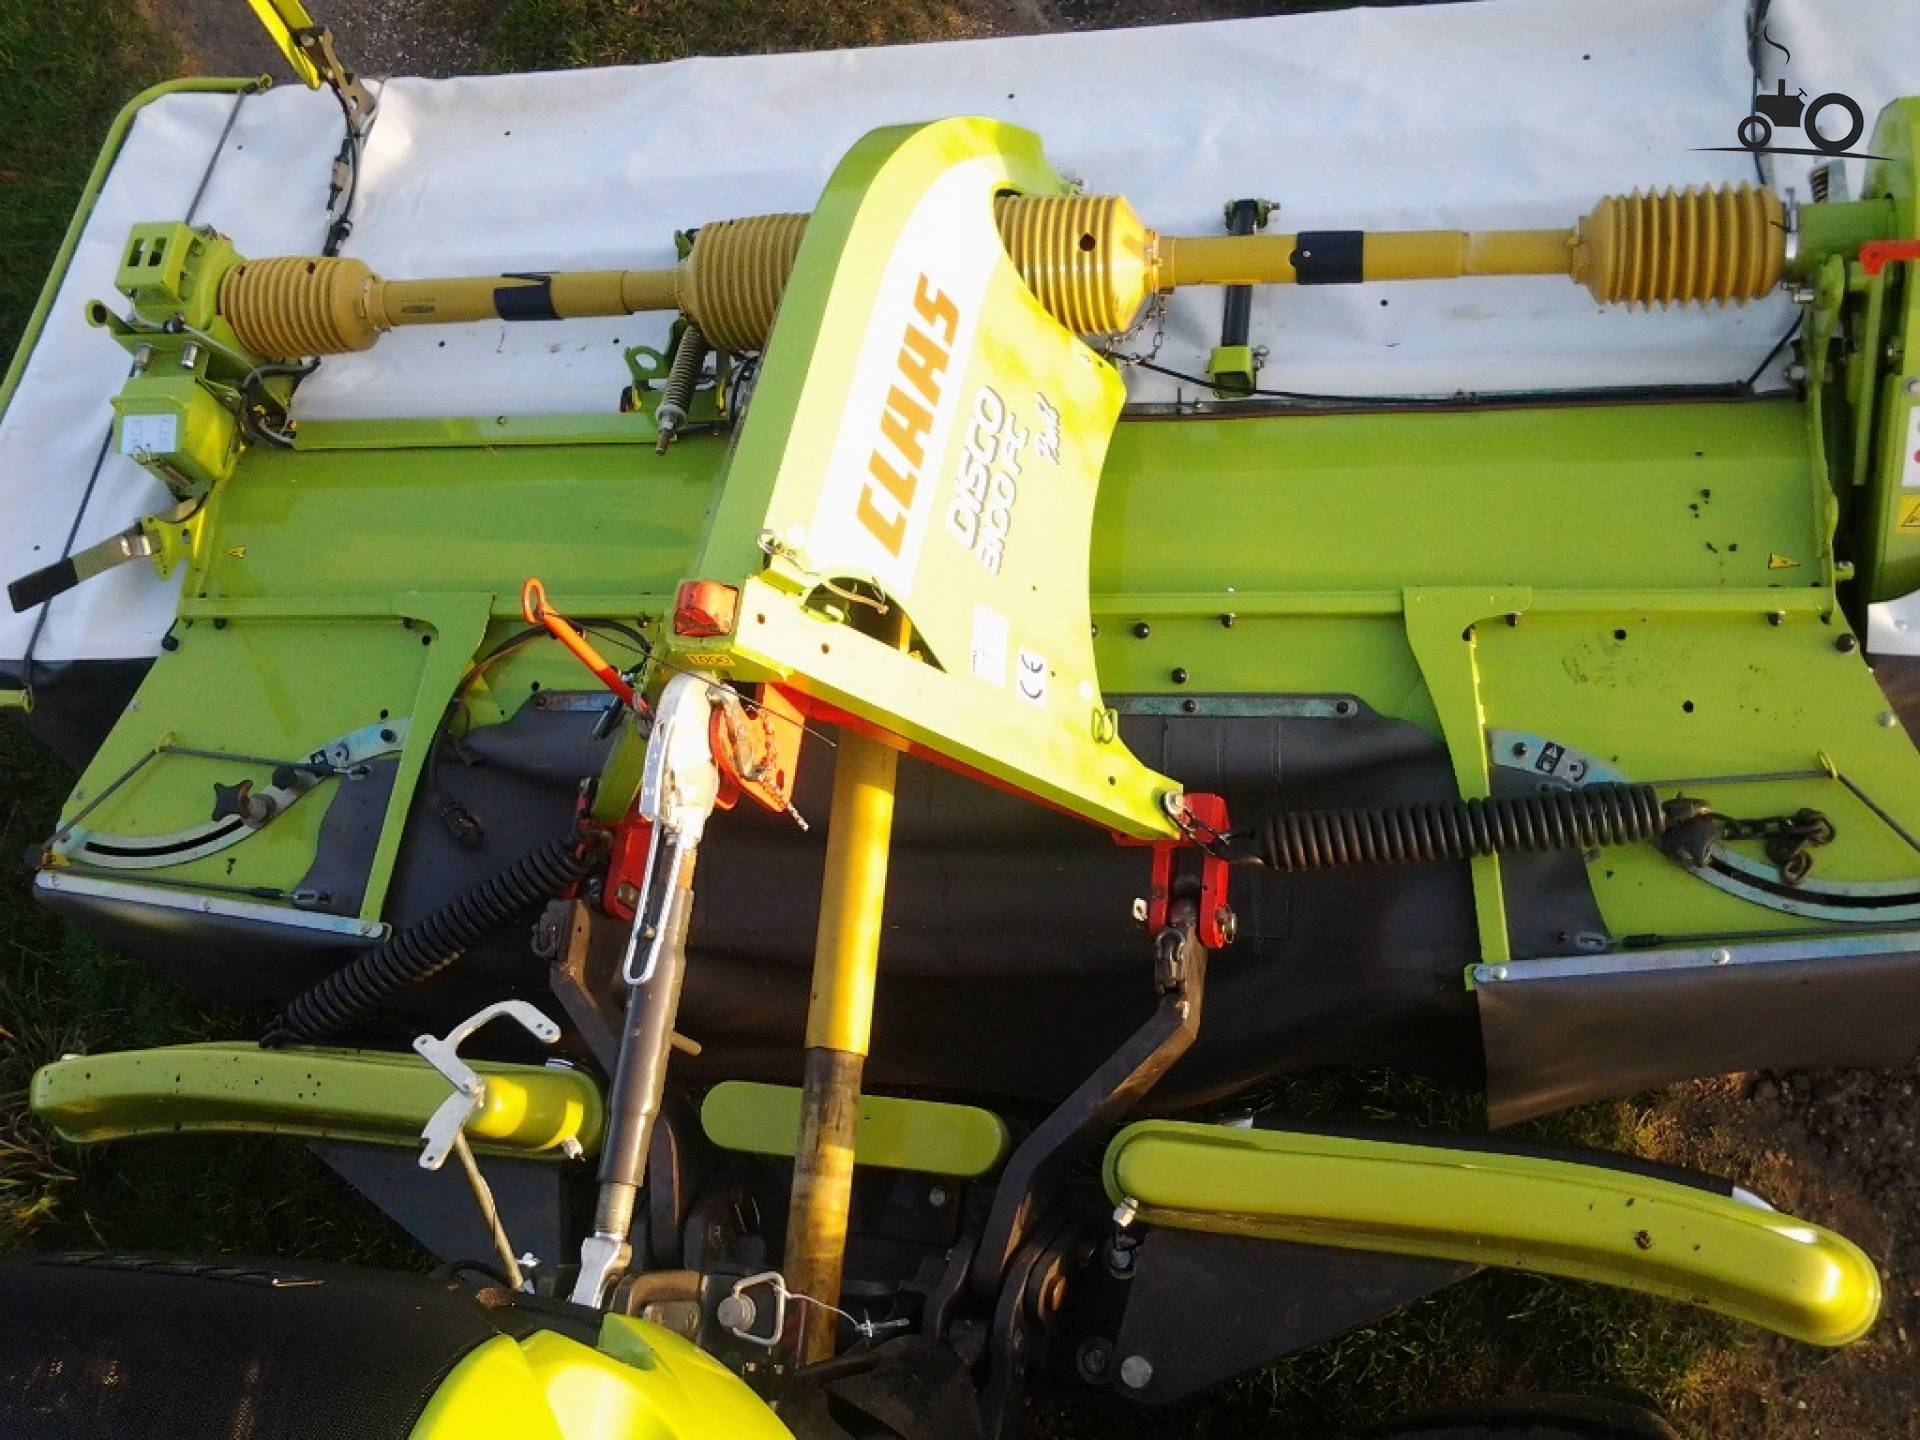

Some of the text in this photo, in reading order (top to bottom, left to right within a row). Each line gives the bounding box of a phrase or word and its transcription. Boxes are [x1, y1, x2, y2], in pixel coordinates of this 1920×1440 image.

[856, 271, 959, 558] CLAAS
[948, 384, 1006, 549] DISCO
[1004, 411, 1030, 475] FC
